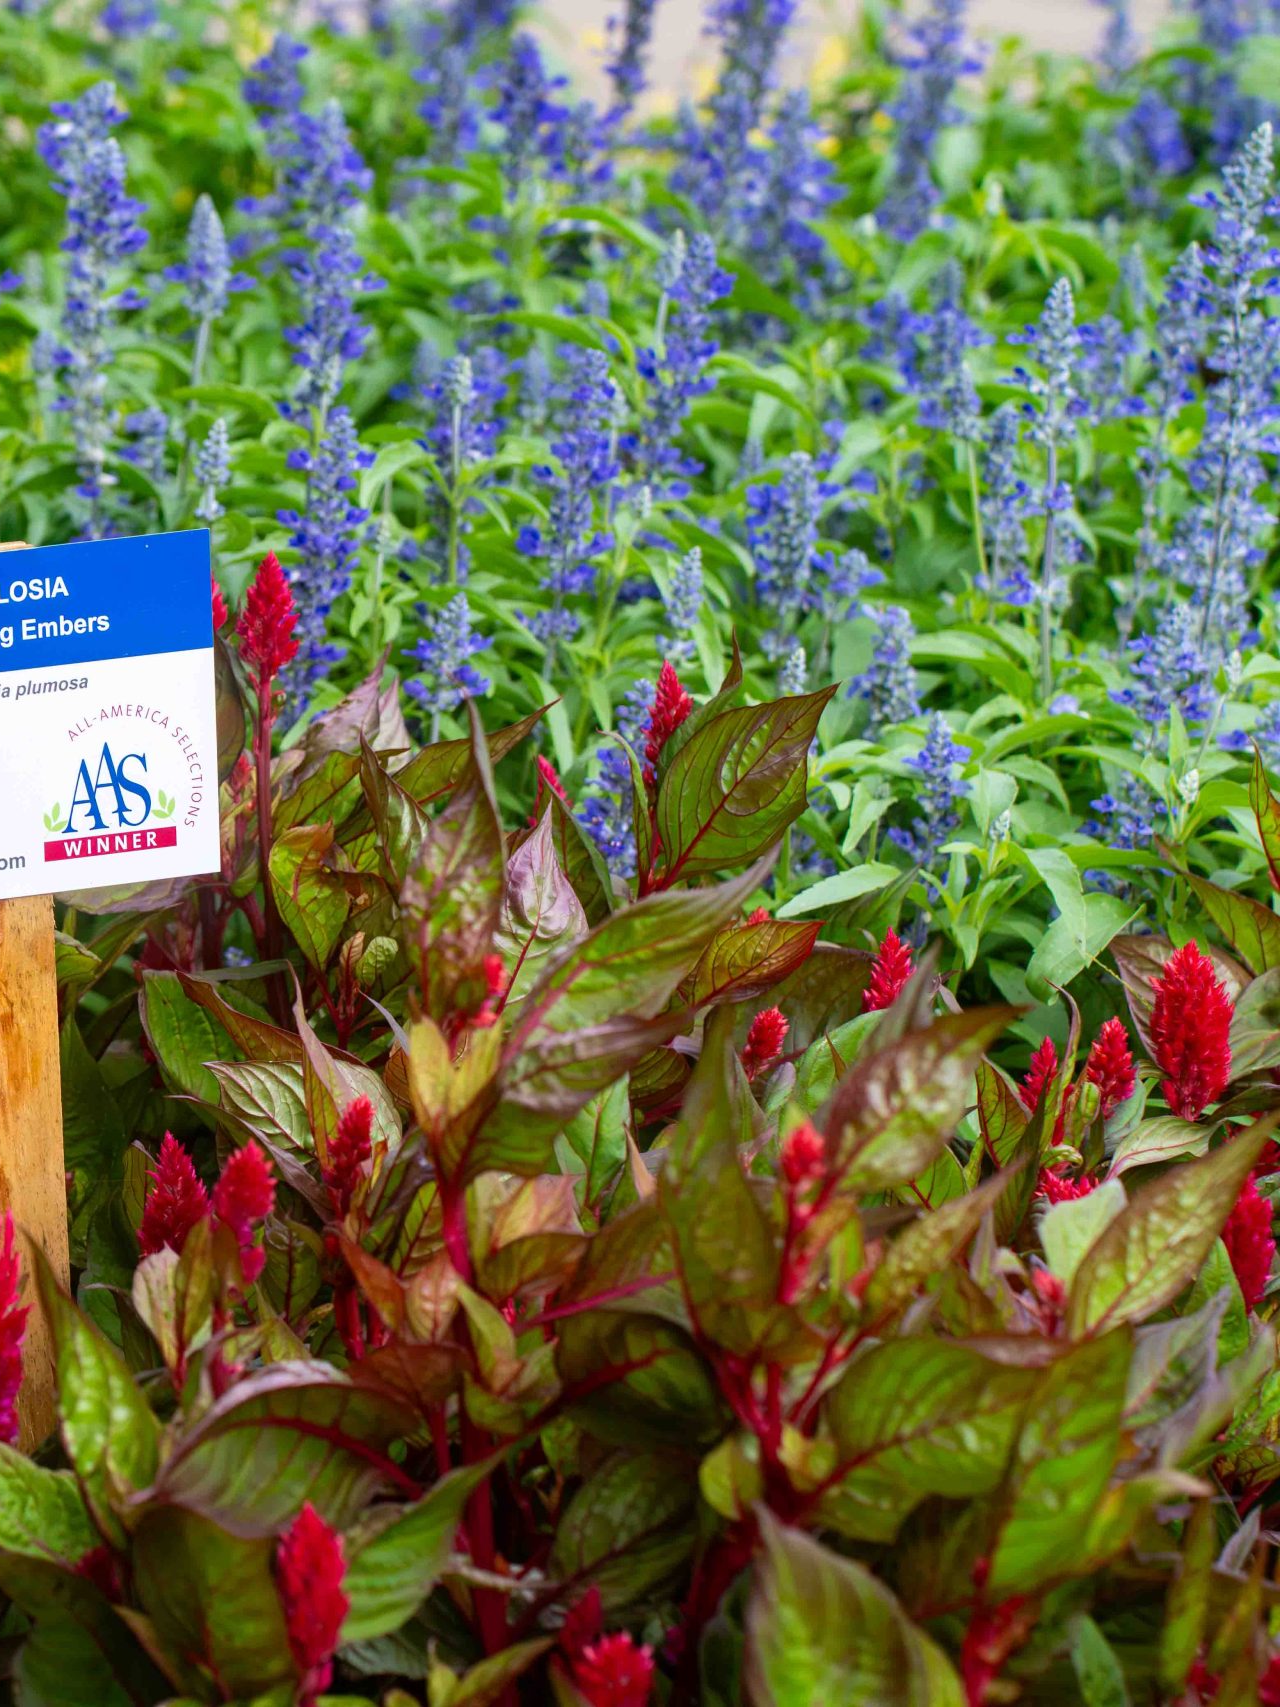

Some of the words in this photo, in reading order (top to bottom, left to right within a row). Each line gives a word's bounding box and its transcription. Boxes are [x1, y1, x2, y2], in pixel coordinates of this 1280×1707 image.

[21, 614, 110, 641] Embers
[15, 677, 89, 702] plumosa
[68, 704, 169, 742] ALL-AMERICA
[171, 726, 203, 828] SELECTIONS
[61, 741, 152, 834] AAS
[64, 831, 158, 857] WINNER
